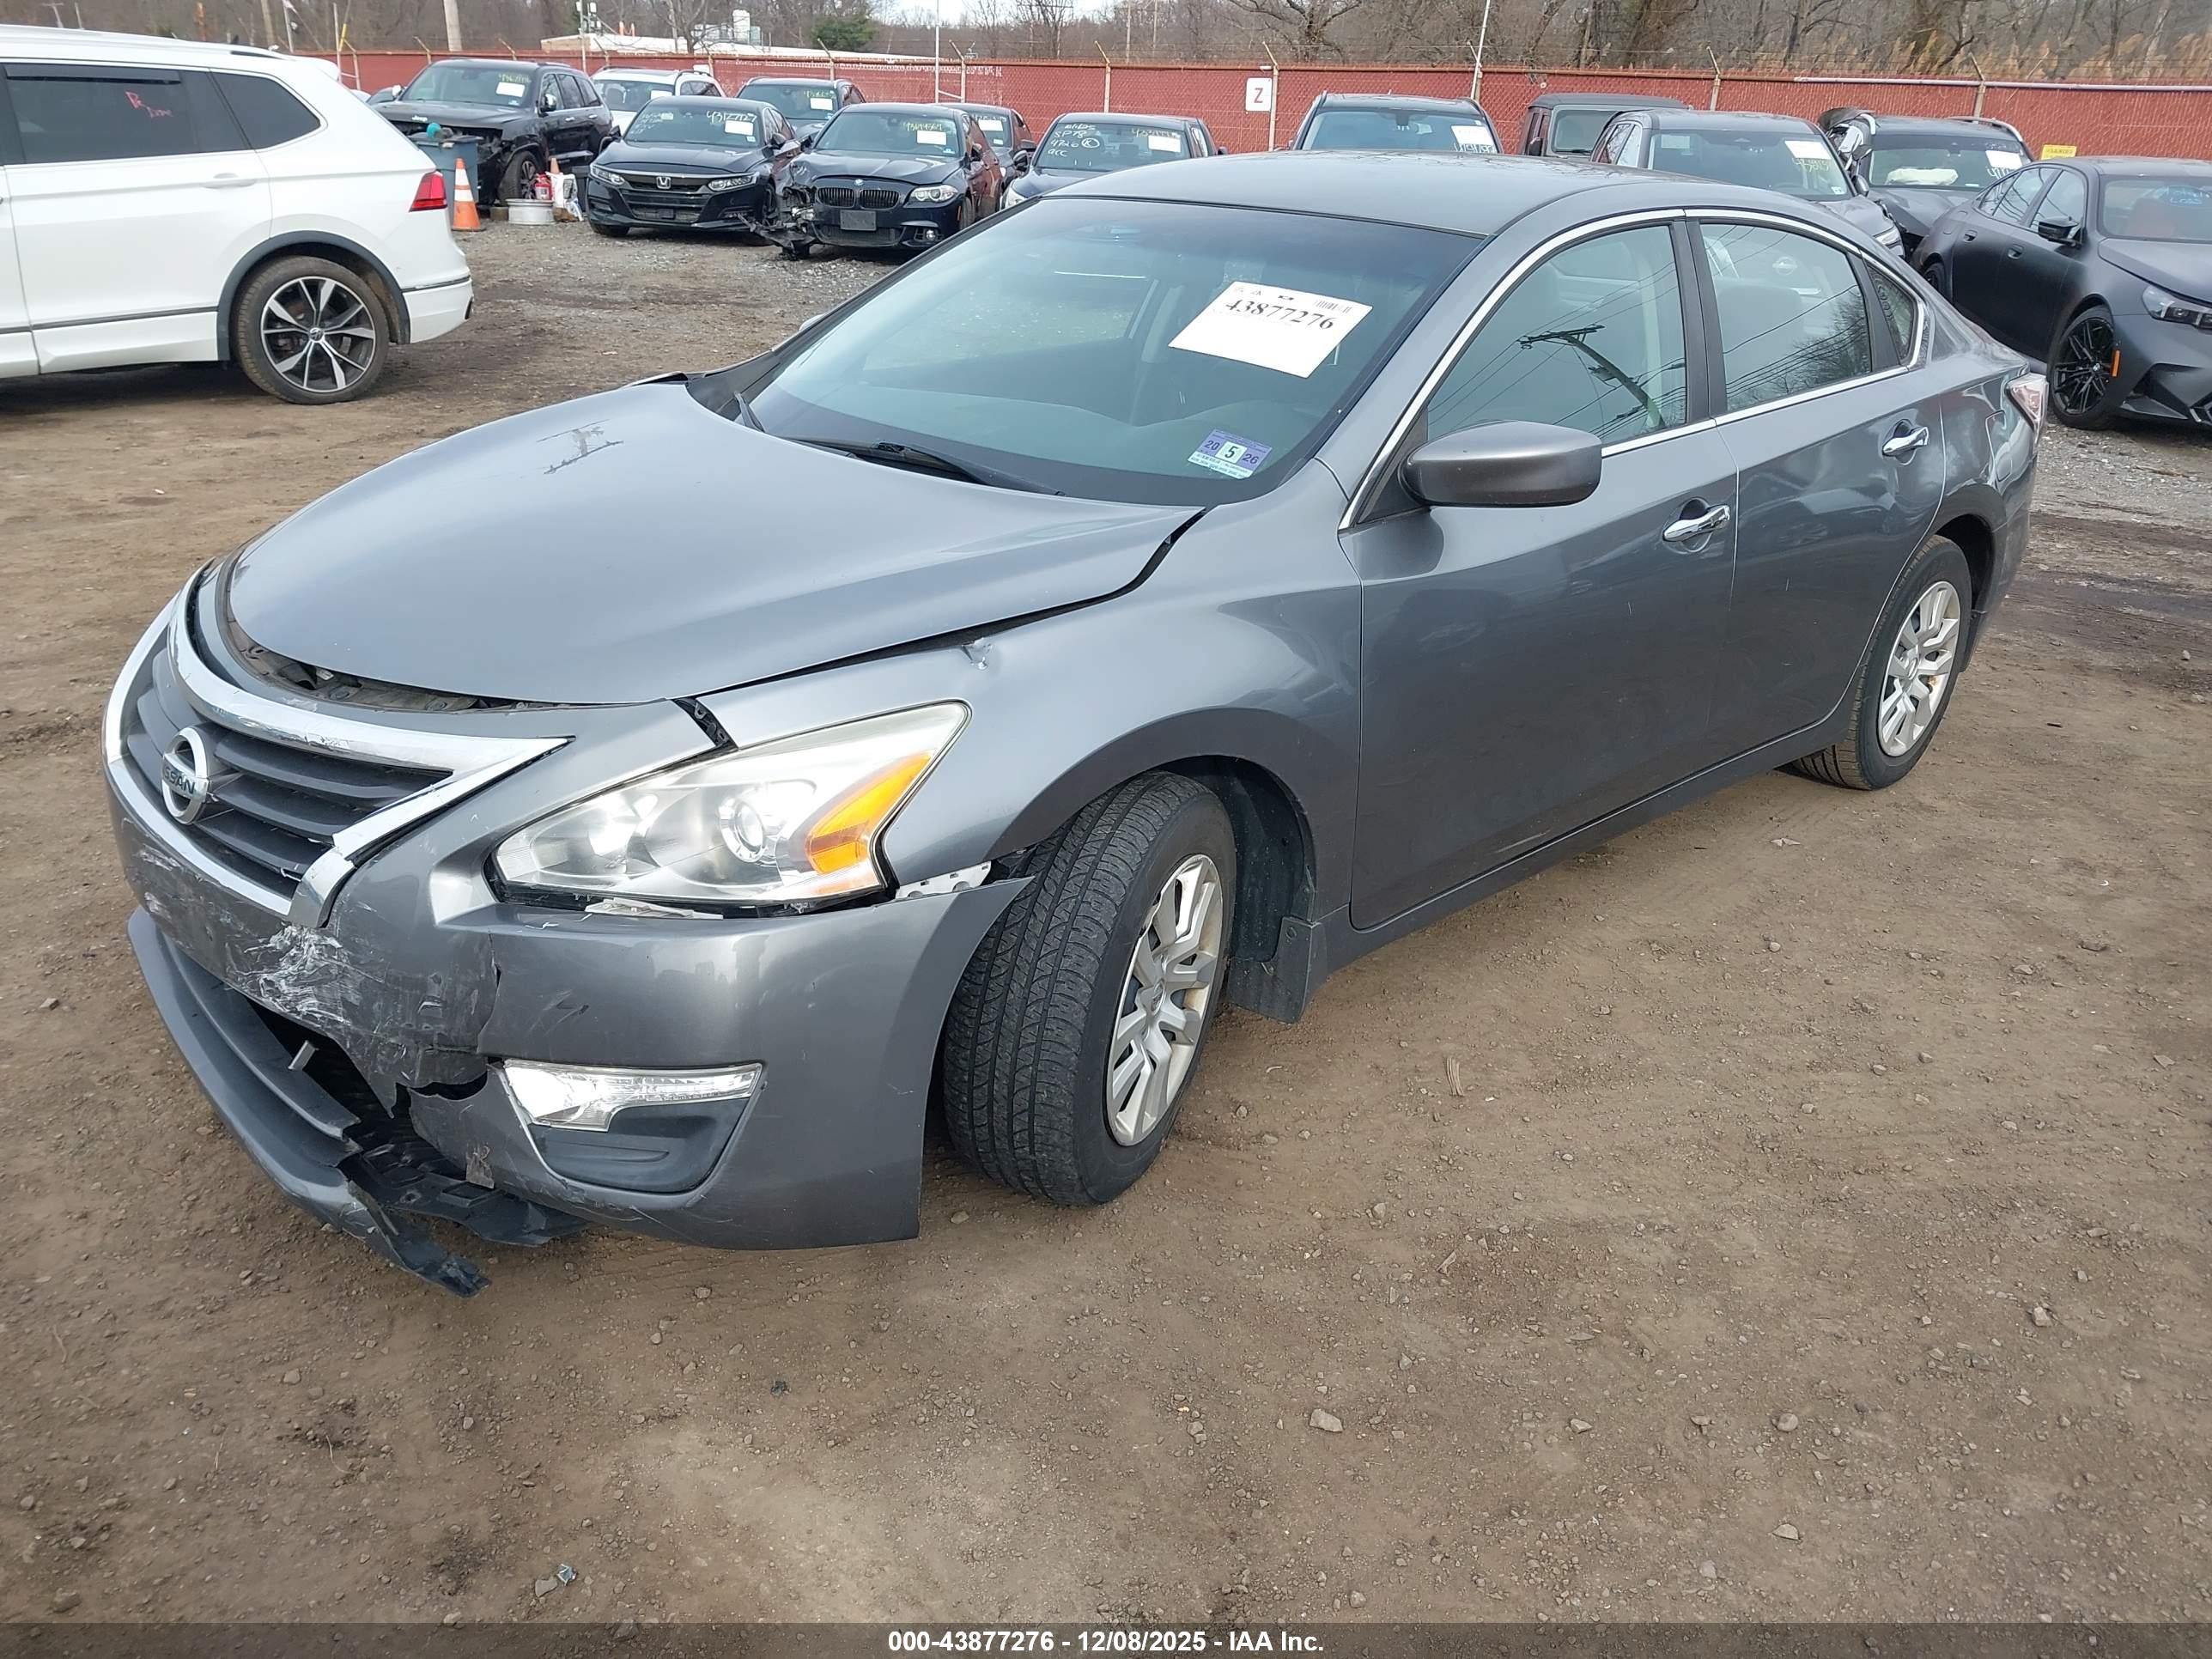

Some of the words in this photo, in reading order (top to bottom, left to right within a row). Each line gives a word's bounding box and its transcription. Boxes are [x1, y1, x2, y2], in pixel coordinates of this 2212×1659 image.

[1254, 88, 1264, 104] Z
[1224, 299, 1335, 330] 43877276
[1205, 440, 1220, 451] 20
[1224, 446, 1238, 459] 5
[1242, 453, 1260, 465] 26
